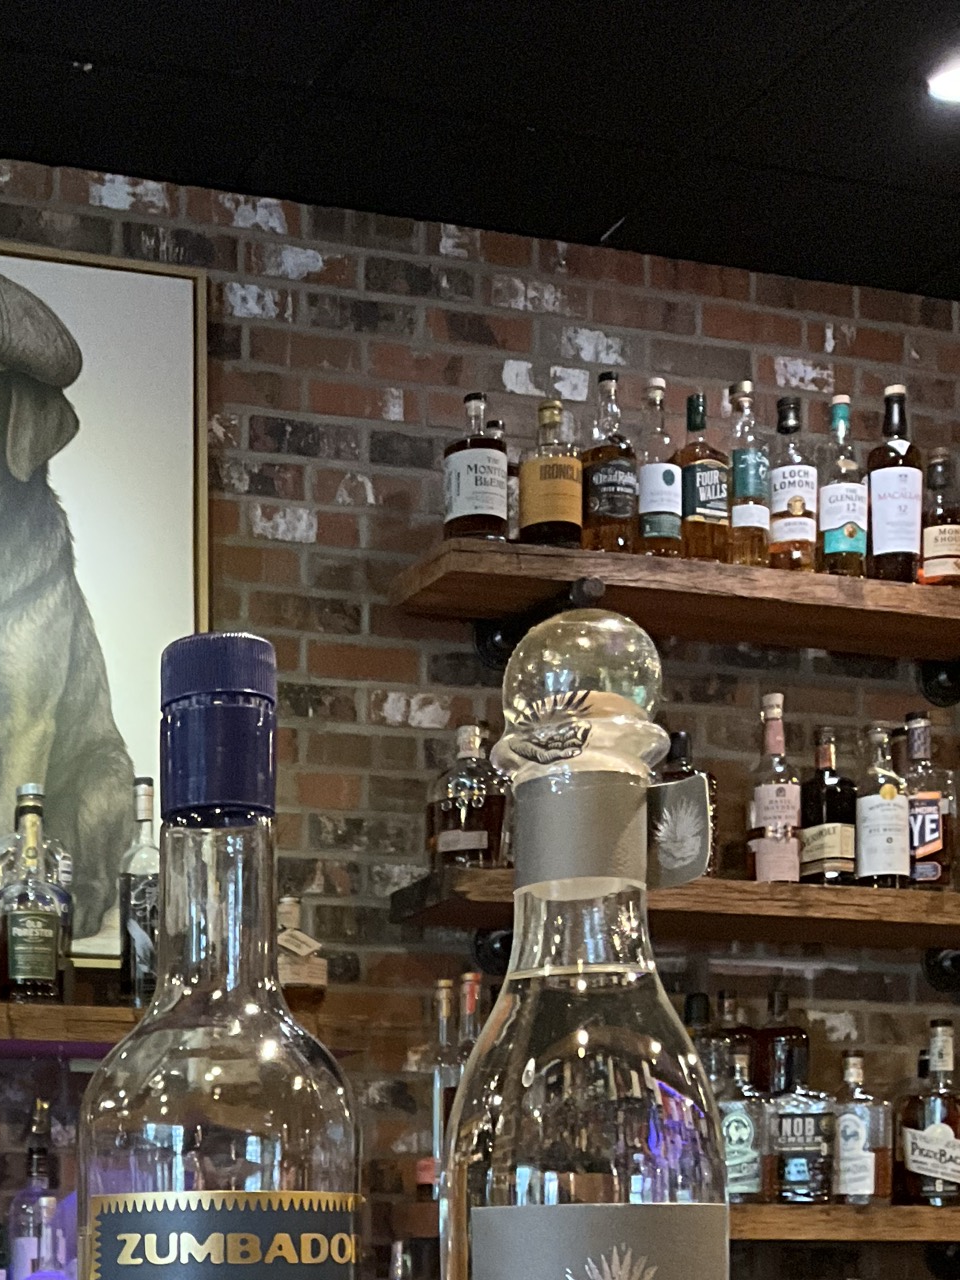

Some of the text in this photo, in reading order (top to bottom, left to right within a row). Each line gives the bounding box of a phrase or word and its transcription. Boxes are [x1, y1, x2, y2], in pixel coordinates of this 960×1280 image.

[696, 470, 720, 487] FOUR
[782, 469, 810, 480] LOCH
[699, 483, 728, 501] WALLS
[773, 480, 815, 492] LOMOND
[846, 503, 857, 512] 12
[909, 814, 940, 847] YE
[770, 1117, 815, 1137] KNOB
[116, 1231, 361, 1265] ZUMBADO
